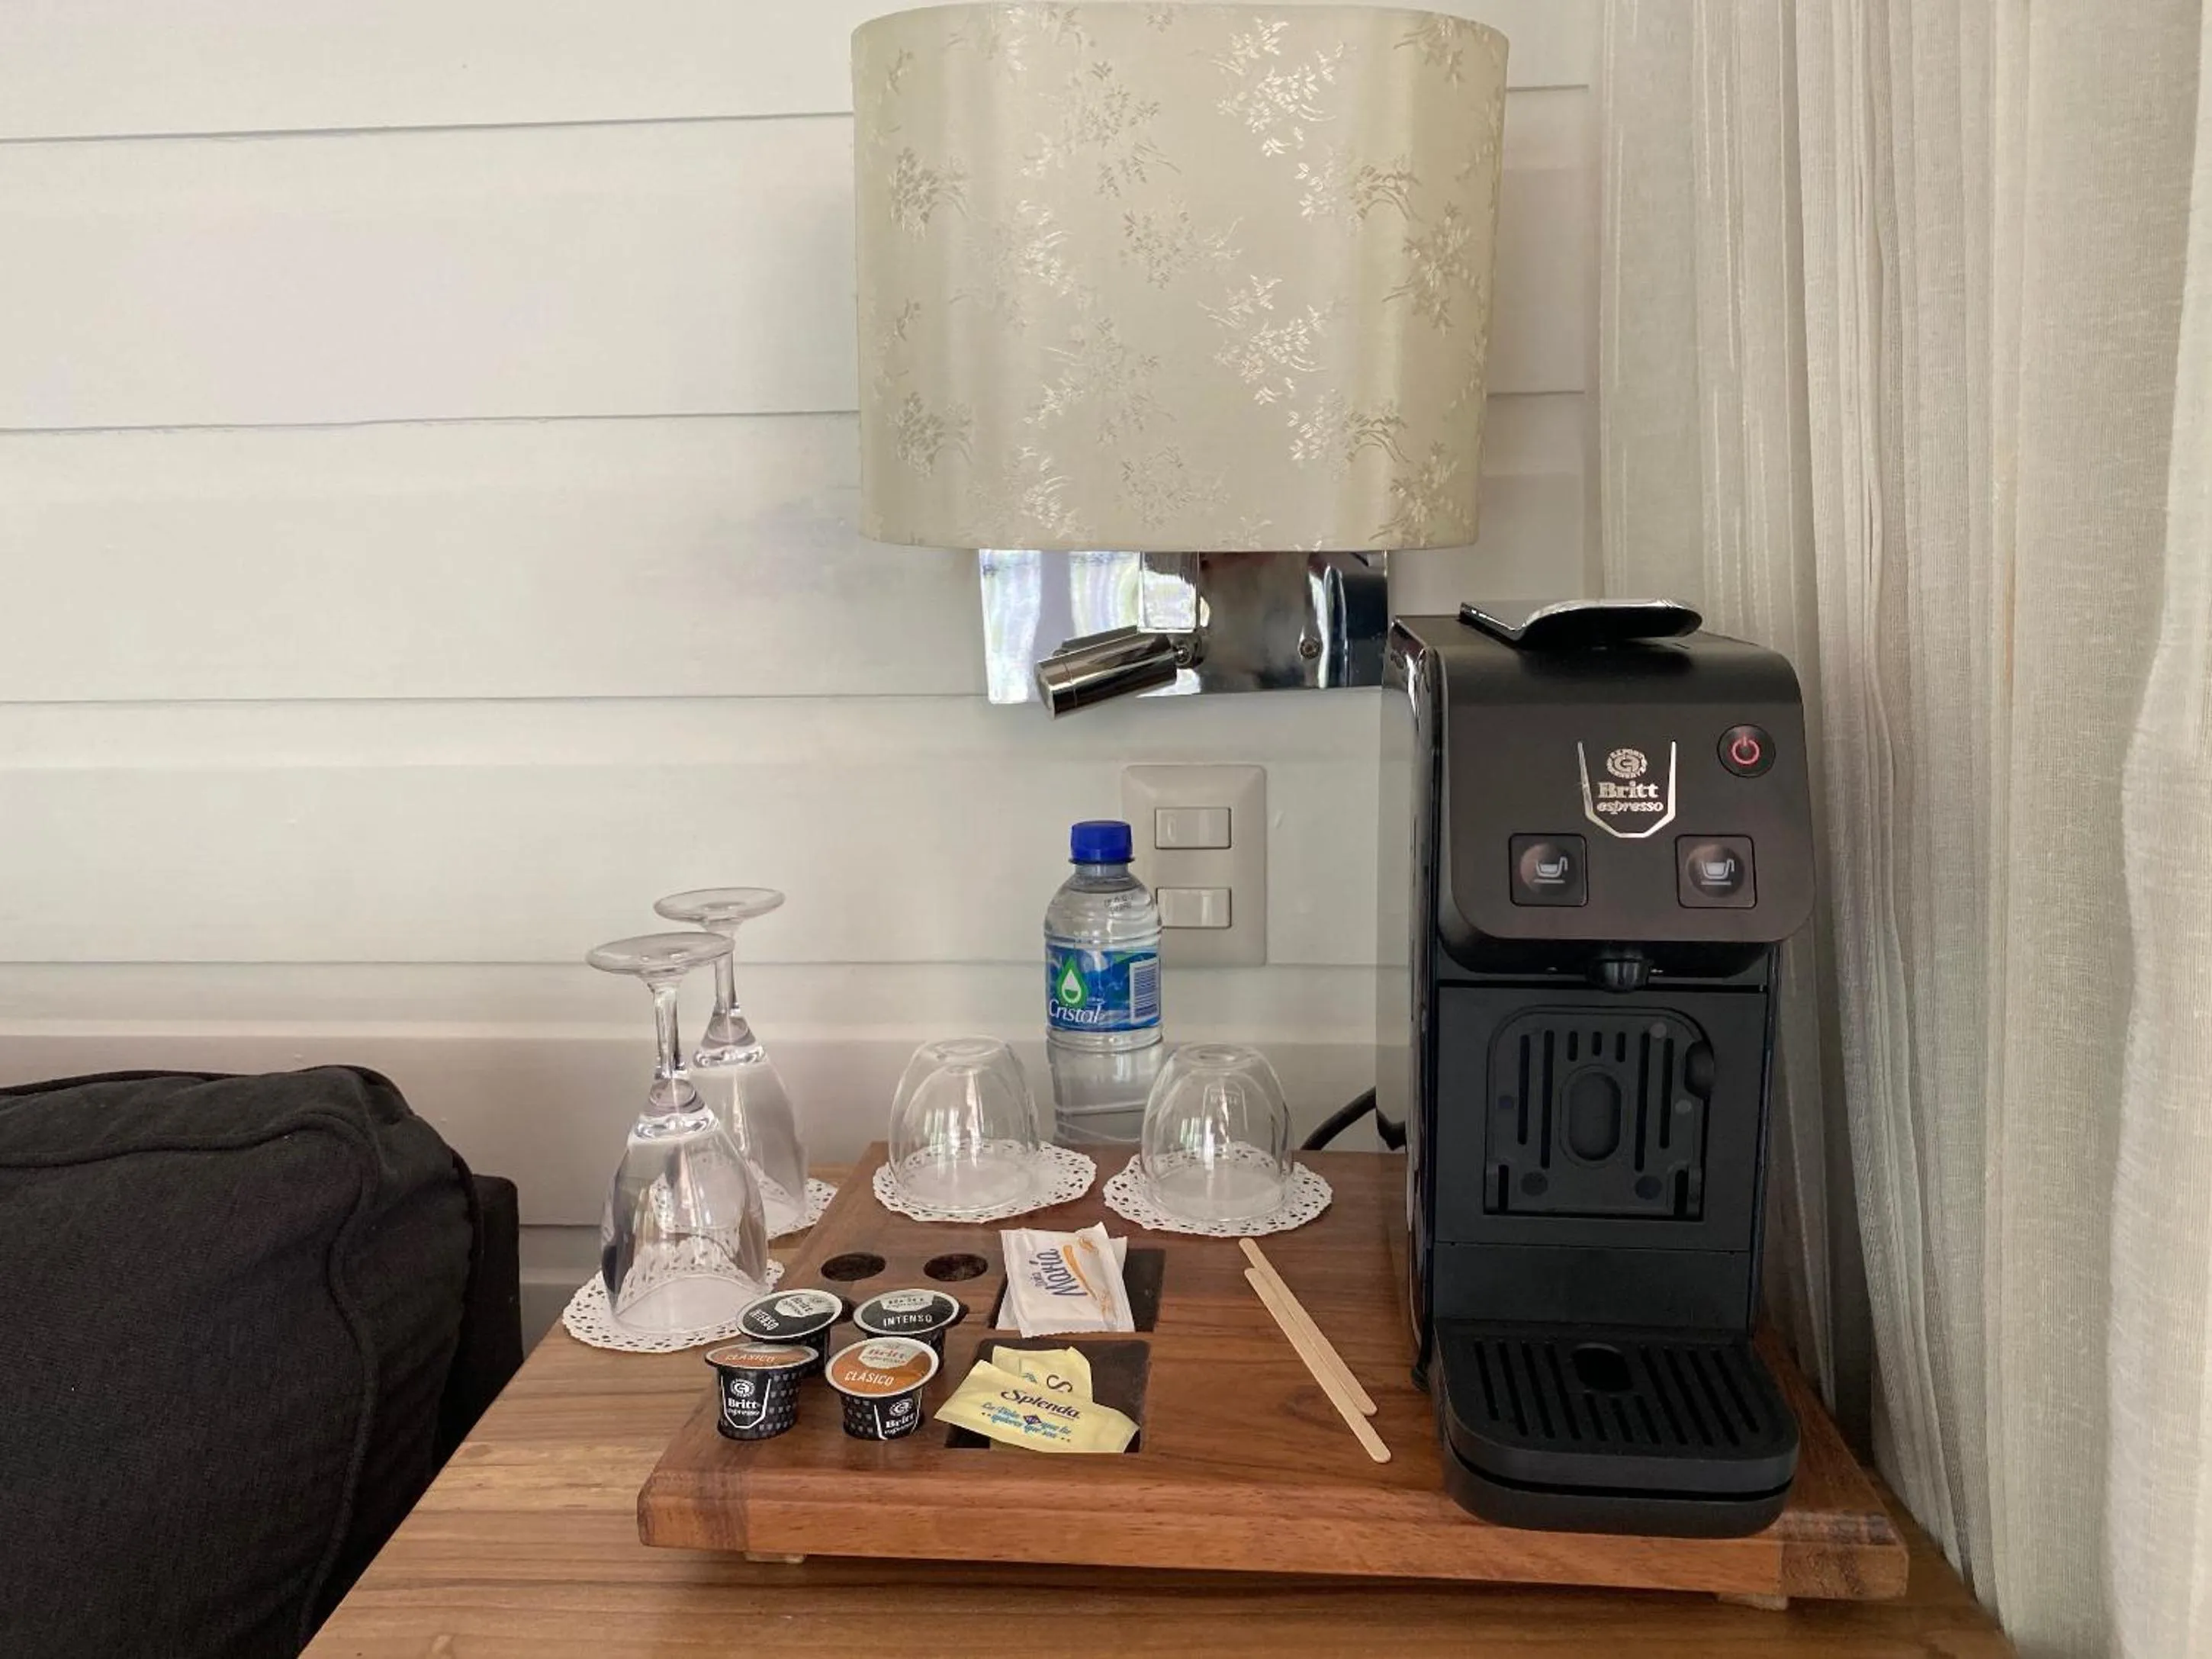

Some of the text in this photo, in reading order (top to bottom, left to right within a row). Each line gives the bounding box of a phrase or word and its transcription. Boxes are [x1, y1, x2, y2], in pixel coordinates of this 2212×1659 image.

[1598, 780, 1659, 799] Britt
[1596, 800, 1664, 815] espresso
[1048, 998, 1101, 1023] Cristal
[883, 1313, 933, 1327] INTENSO
[728, 1397, 758, 1410] Britt
[1000, 1389, 1081, 1419] Splenda
[886, 1413, 915, 1429] Britt
